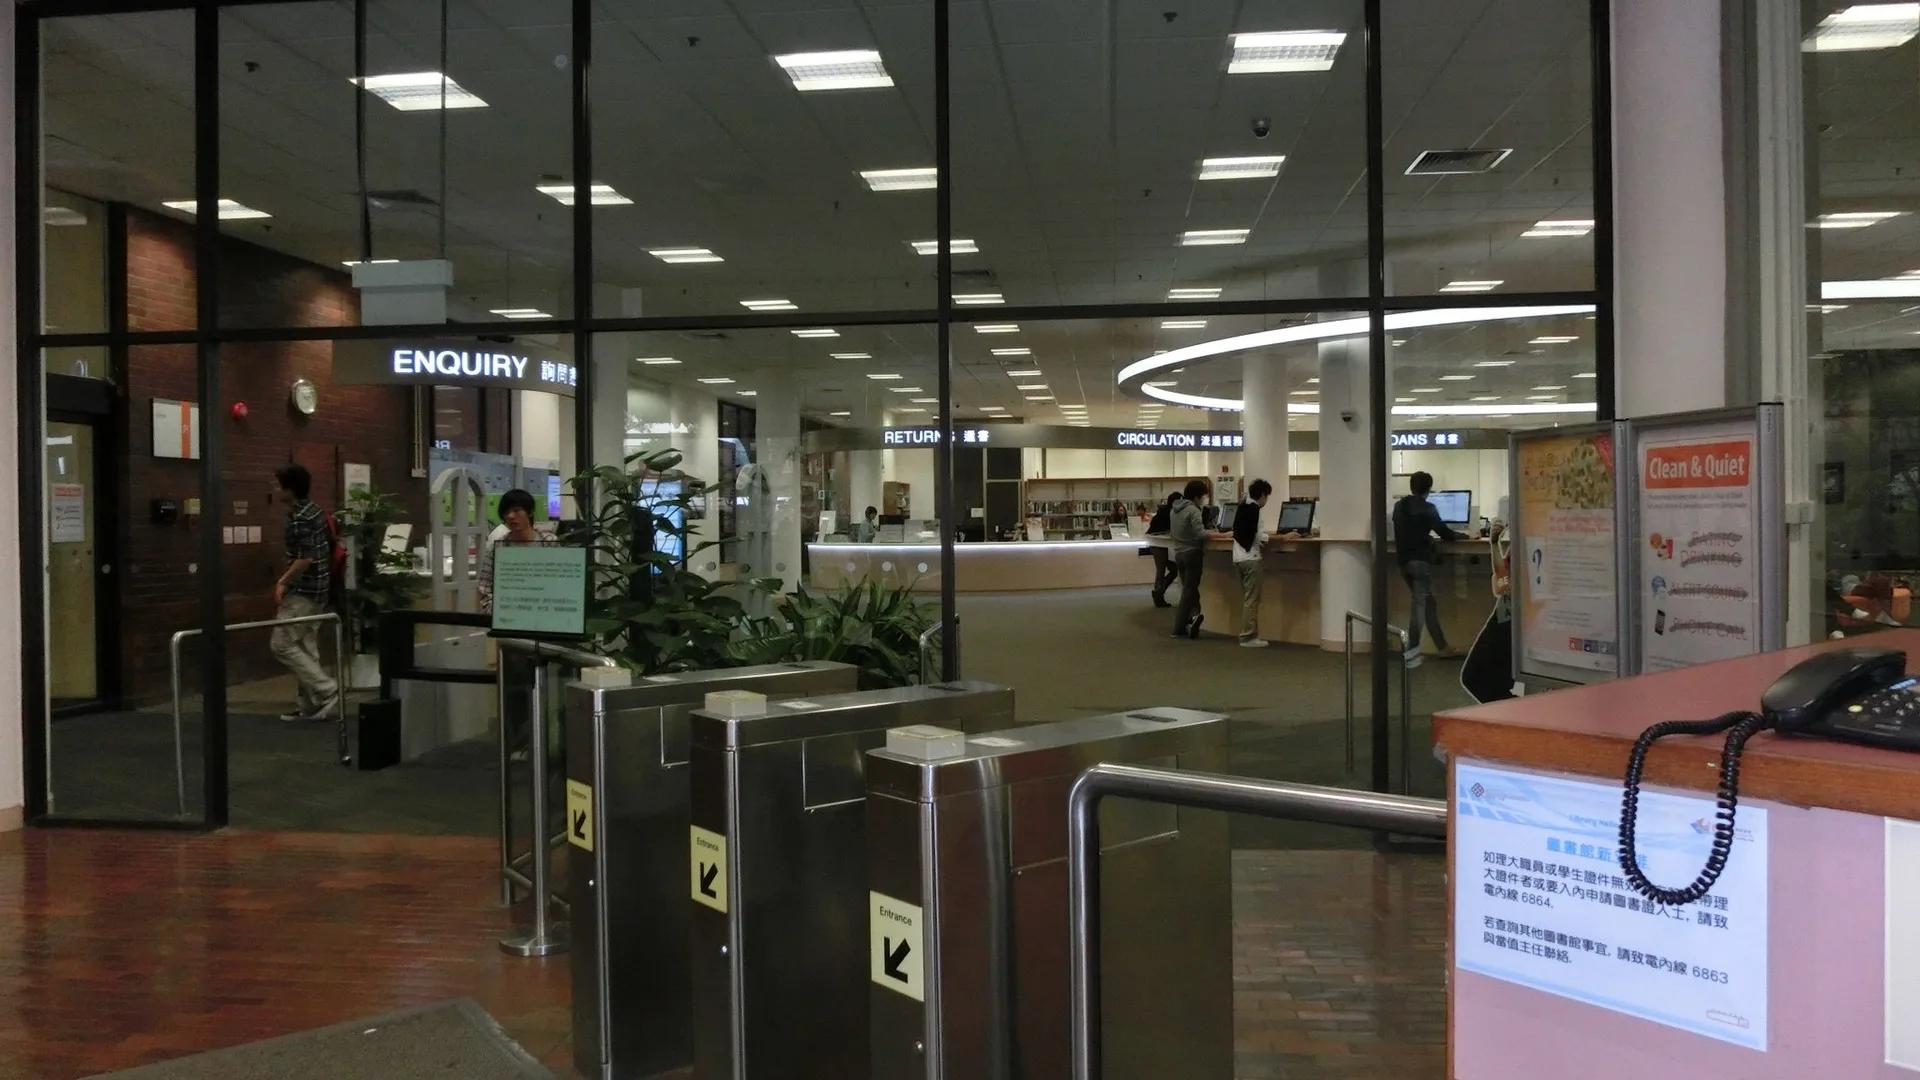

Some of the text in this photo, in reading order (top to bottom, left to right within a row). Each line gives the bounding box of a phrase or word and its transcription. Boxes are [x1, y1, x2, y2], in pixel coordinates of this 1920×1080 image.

[393, 350, 528, 378] ENQUIRY
[1117, 432, 1195, 447] CIRCULATION
[1649, 452, 1745, 479] Clean & Quiet
[697, 836, 720, 851] Entrance
[880, 905, 912, 926] Entrance
[1692, 966, 1729, 985] 6863
